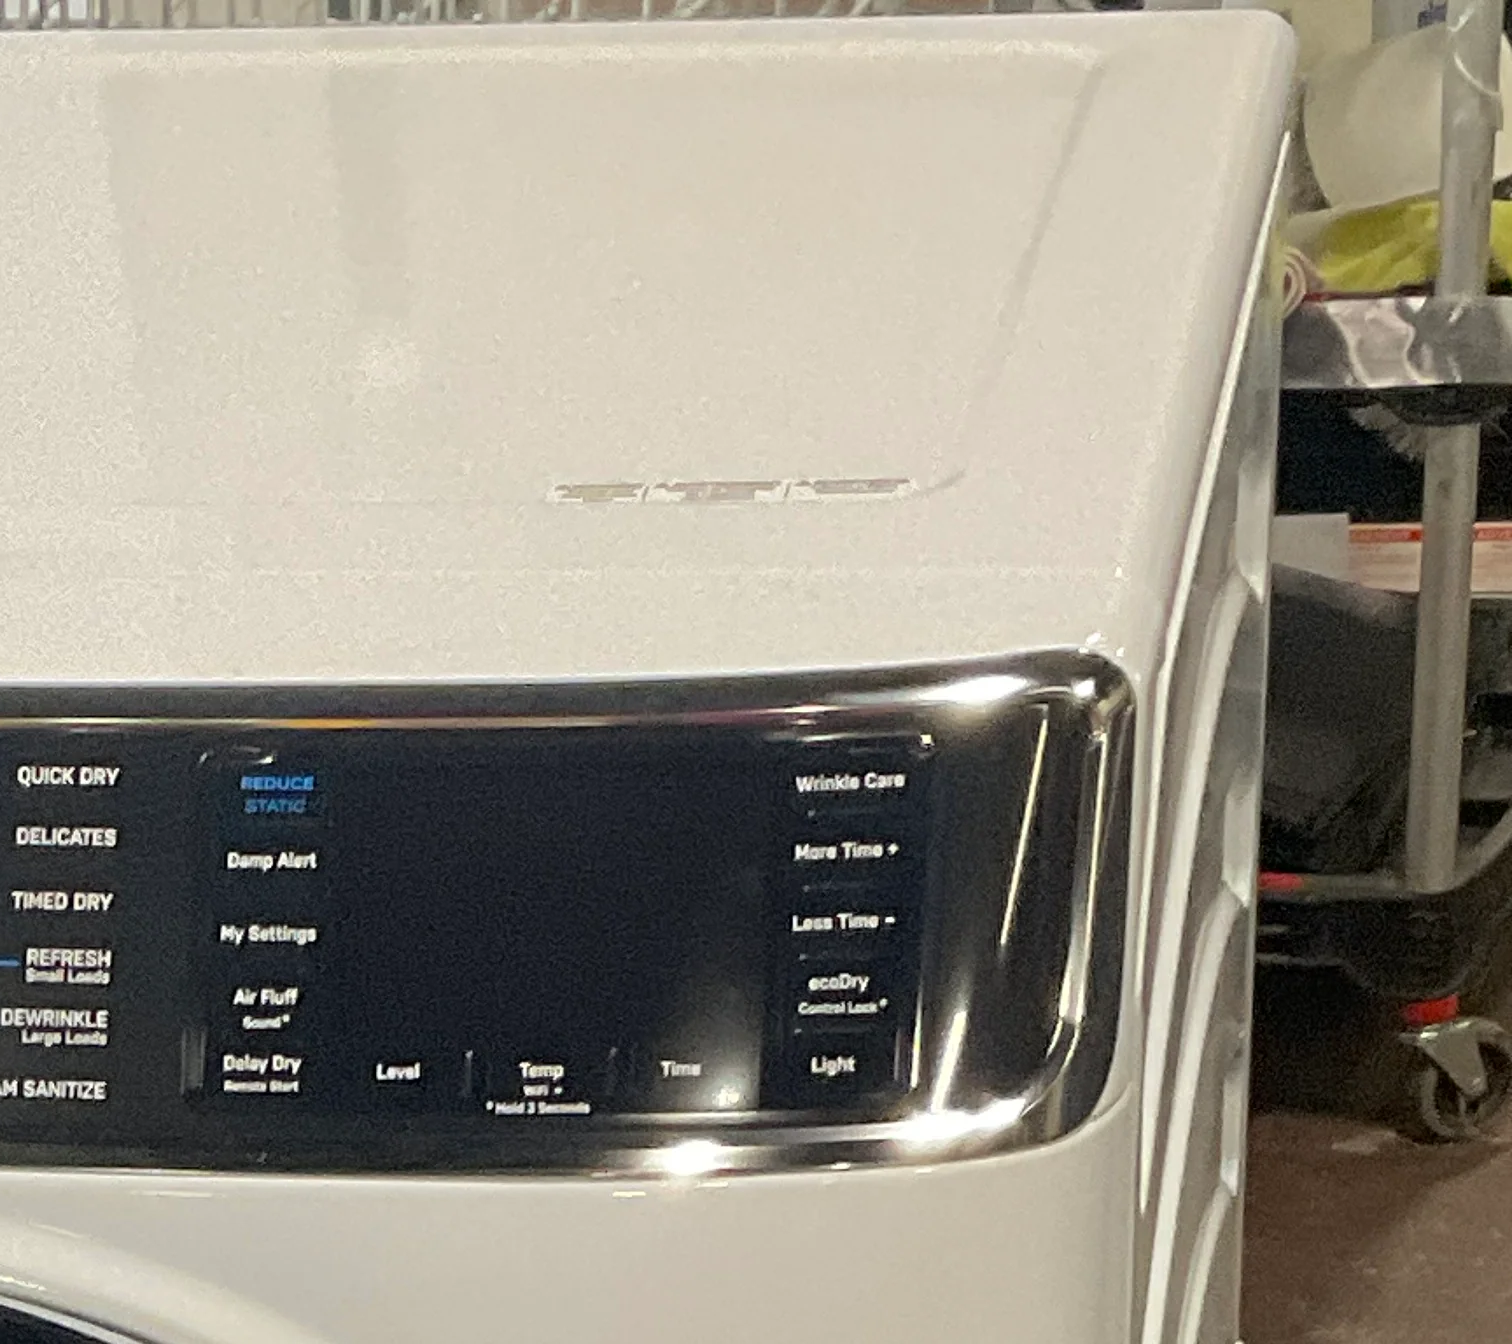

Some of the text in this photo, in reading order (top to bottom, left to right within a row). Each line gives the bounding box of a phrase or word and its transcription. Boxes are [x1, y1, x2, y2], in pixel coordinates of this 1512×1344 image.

[18, 766, 119, 787] QUICK DRY
[241, 776, 313, 791] REDUCE
[796, 772, 905, 792] Wrinkle Care
[244, 798, 306, 813] STATIC
[16, 827, 116, 847] DELICATES
[795, 844, 837, 860] More
[841, 842, 883, 859] Time
[228, 852, 317, 872] Damp Alert
[12, 891, 113, 910] TIMED DRY
[793, 915, 833, 931] Less
[837, 913, 879, 929] Time
[221, 925, 316, 945] My Settings
[26, 948, 111, 967] REFRESH
[26, 968, 109, 984] Small Loads
[809, 973, 869, 992] ecoDry
[234, 988, 298, 1005] Air Fluff
[798, 1002, 845, 1014] Control
[1, 1008, 108, 1028] DEWRINKLE
[22, 1029, 107, 1047] Large Loads
[224, 1054, 301, 1074] Delay Dry
[376, 1063, 420, 1080] Level
[519, 1062, 564, 1080] Temp
[661, 1061, 701, 1077] Time
[811, 1056, 855, 1076] Light
[24, 1080, 106, 1099] SANITIZE
